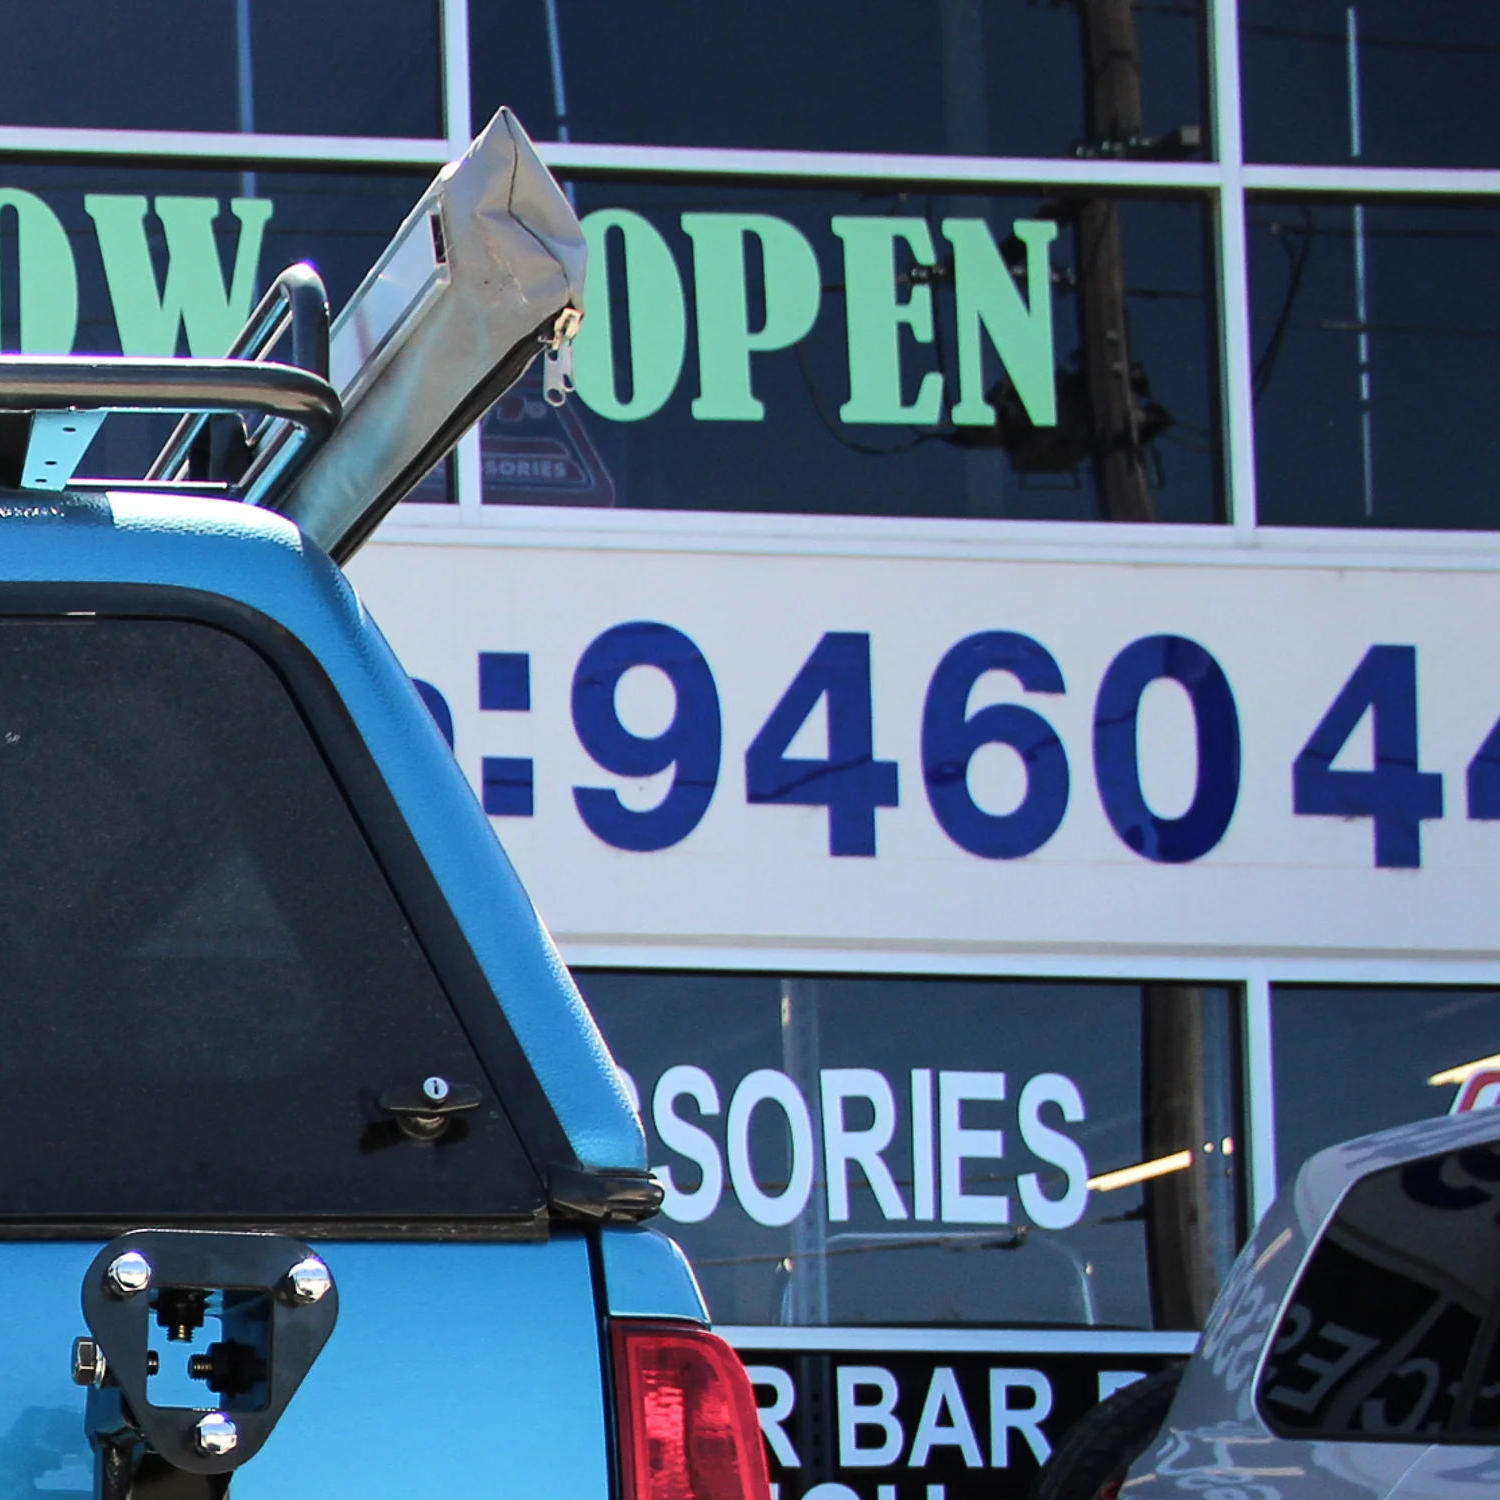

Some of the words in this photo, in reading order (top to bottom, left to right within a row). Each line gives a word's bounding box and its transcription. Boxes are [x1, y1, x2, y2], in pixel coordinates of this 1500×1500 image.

[571, 208, 1058, 427] OPEN
[1292, 644, 1500, 867] 4
[618, 1065, 1092, 1230] SORIES
[837, 1366, 1052, 1468] BAR
